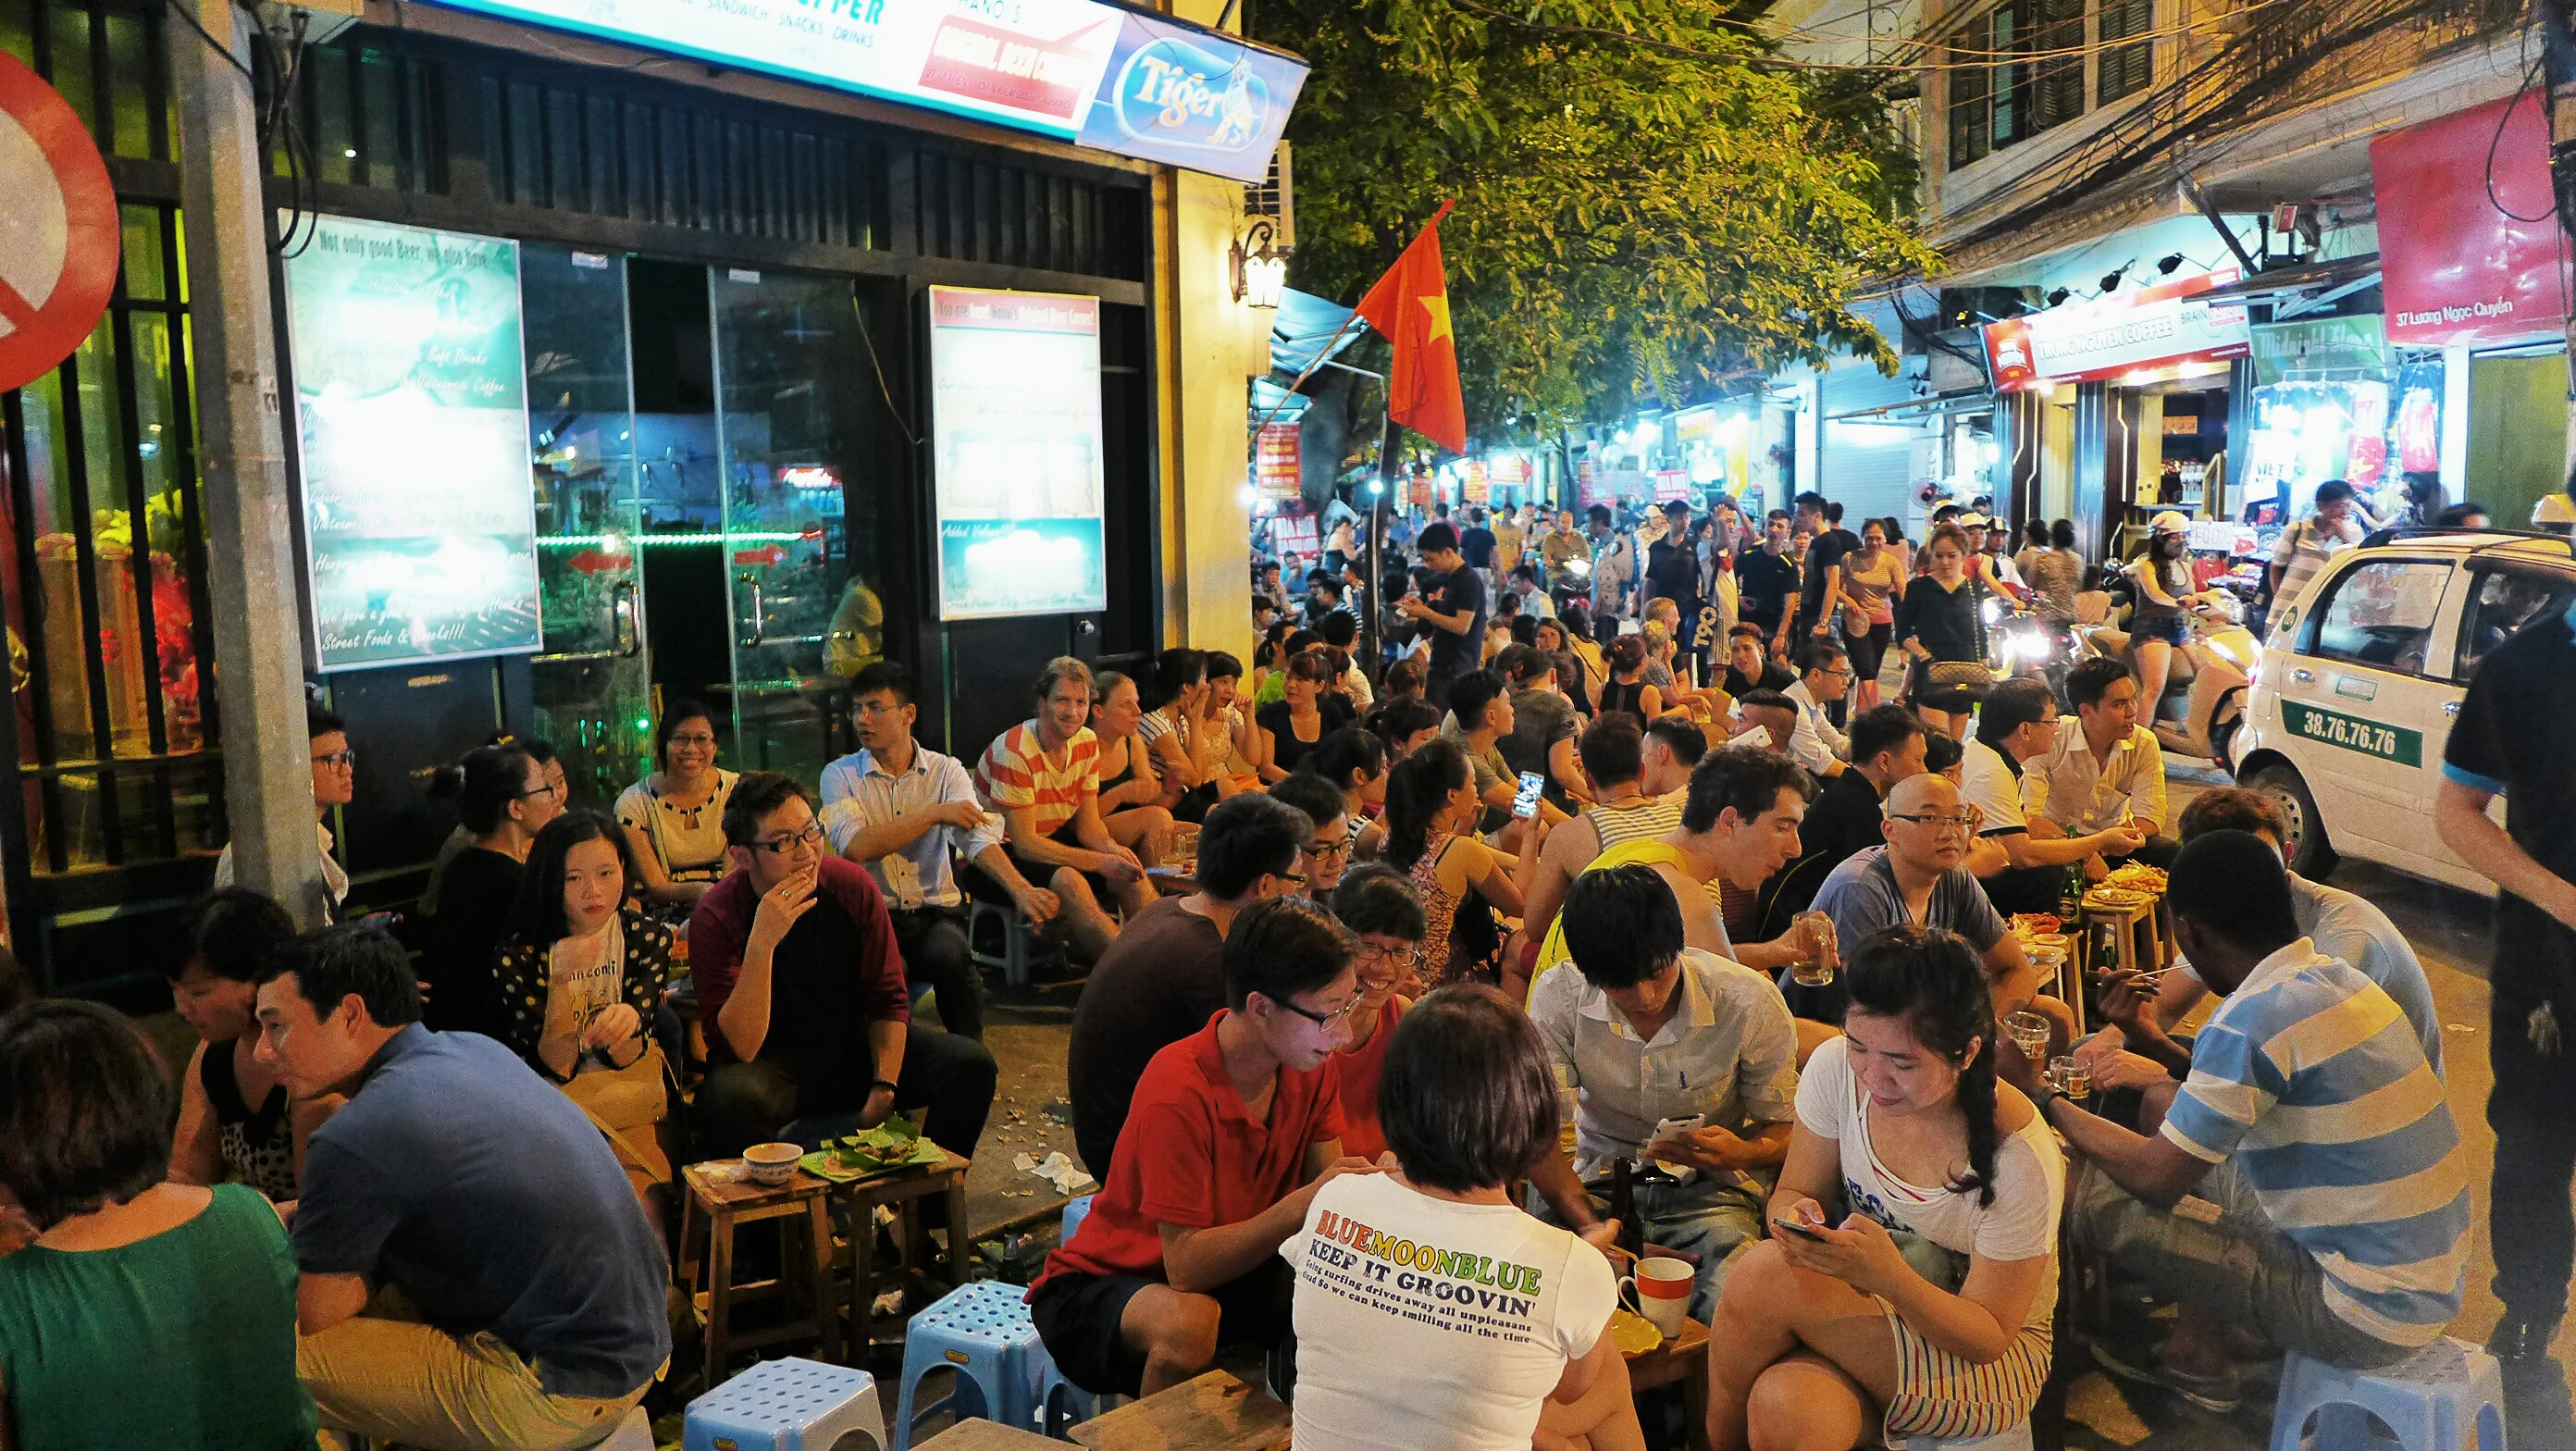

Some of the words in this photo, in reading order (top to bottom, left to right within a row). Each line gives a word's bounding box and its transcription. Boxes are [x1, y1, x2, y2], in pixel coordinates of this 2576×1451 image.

[779, 12, 824, 36] SNACKS
[832, 26, 874, 49] DRINKS
[1133, 56, 1225, 128] Tiger
[318, 230, 339, 252] Not
[342, 234, 365, 258] only
[368, 238, 393, 259] good
[2125, 316, 2173, 344] COFFEE
[2396, 313, 2409, 327] 37
[426, 345, 452, 368] Soft
[454, 346, 489, 366] Drinks
[473, 375, 505, 399] Coffee
[942, 523, 971, 539] Added
[341, 607, 366, 626] have
[322, 632, 361, 652] Street
[364, 628, 394, 649] Foods
[397, 627, 409, 645] &
[2304, 710, 2396, 755] 38.76.76.76
[1315, 1209, 1542, 1296] BLUEMOONBLUE
[1306, 1259, 1323, 1275] Going
[1324, 1270, 1363, 1291] surfing
[1365, 1284, 1402, 1302] drives
[1405, 1296, 1435, 1312] away
[1439, 1306, 1455, 1317] all
[1308, 1238, 1358, 1271] KEEP
[1363, 1259, 1392, 1283] IT
[1396, 1271, 1536, 1318] GROOVIN'
[1318, 1278, 1329, 1290] So
[1331, 1285, 1345, 1297] we
[1348, 1292, 1368, 1306] can
[1371, 1298, 1399, 1316] keep
[1455, 1322, 1473, 1333] all
[1477, 1327, 1499, 1339] the
[1504, 1333, 1530, 1344] time
